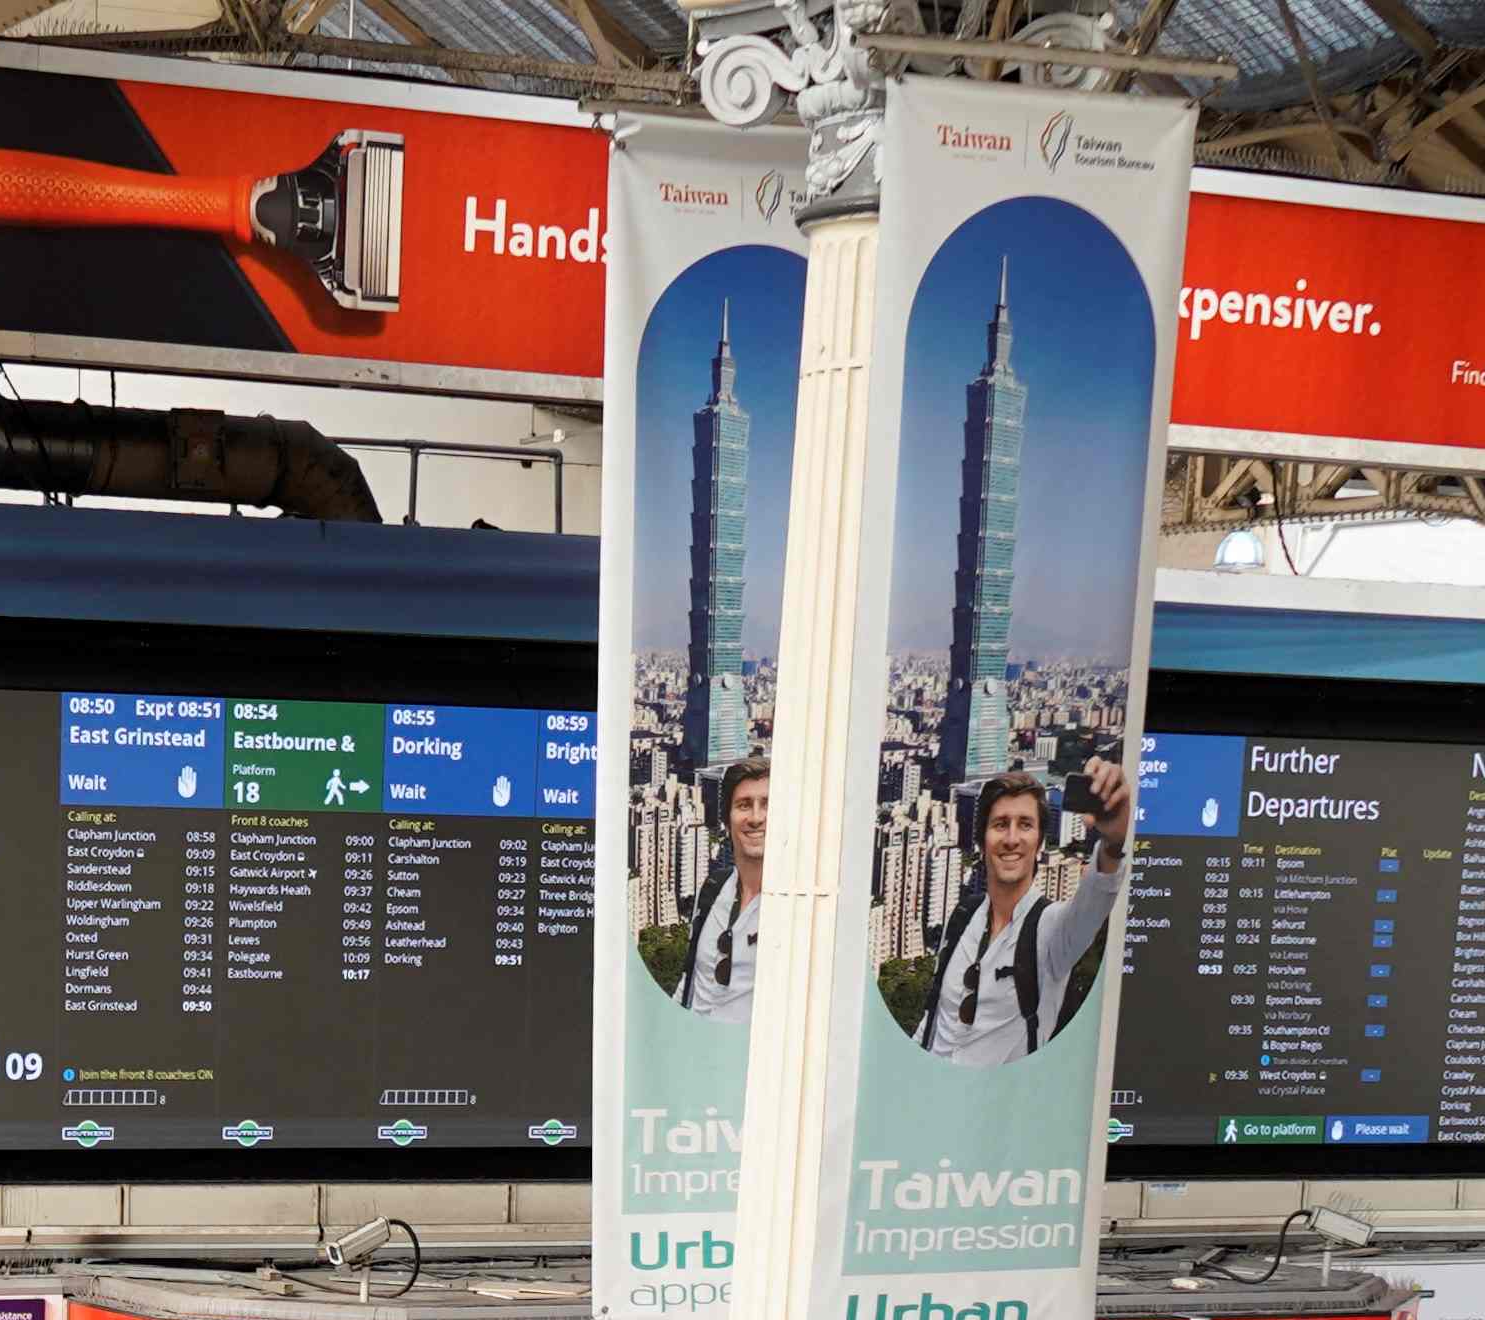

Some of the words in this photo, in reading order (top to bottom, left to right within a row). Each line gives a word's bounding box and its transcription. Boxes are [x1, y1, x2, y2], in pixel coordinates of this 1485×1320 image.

[937, 125, 1011, 151] Taiwan
[1077, 135, 1122, 152] Taiwan
[1075, 153, 1116, 167] Tourism
[1117, 156, 1154, 170] Bureau
[659, 183, 728, 205] Taiwan
[69, 697, 115, 714] 08:50
[136, 700, 174, 720] Expt
[178, 701, 221, 718] 08:51
[234, 703, 278, 720] 08:54
[70, 725, 109, 744] East
[114, 727, 205, 747] Grinstead
[234, 731, 337, 751] Eastbourne
[341, 735, 355, 752] &
[232, 764, 275, 776] Platform
[233, 781, 260, 803] 18
[67, 828, 112, 842] Clapham
[113, 830, 156, 842] Junction
[186, 831, 215, 843] 08:58
[6, 1053, 43, 1080] 09
[1225, 1070, 1249, 1080] 09:36
[1259, 1071, 1281, 1080] West
[1281, 1070, 1316, 1082] Croydon
[858, 1158, 1080, 1210] Taiwan
